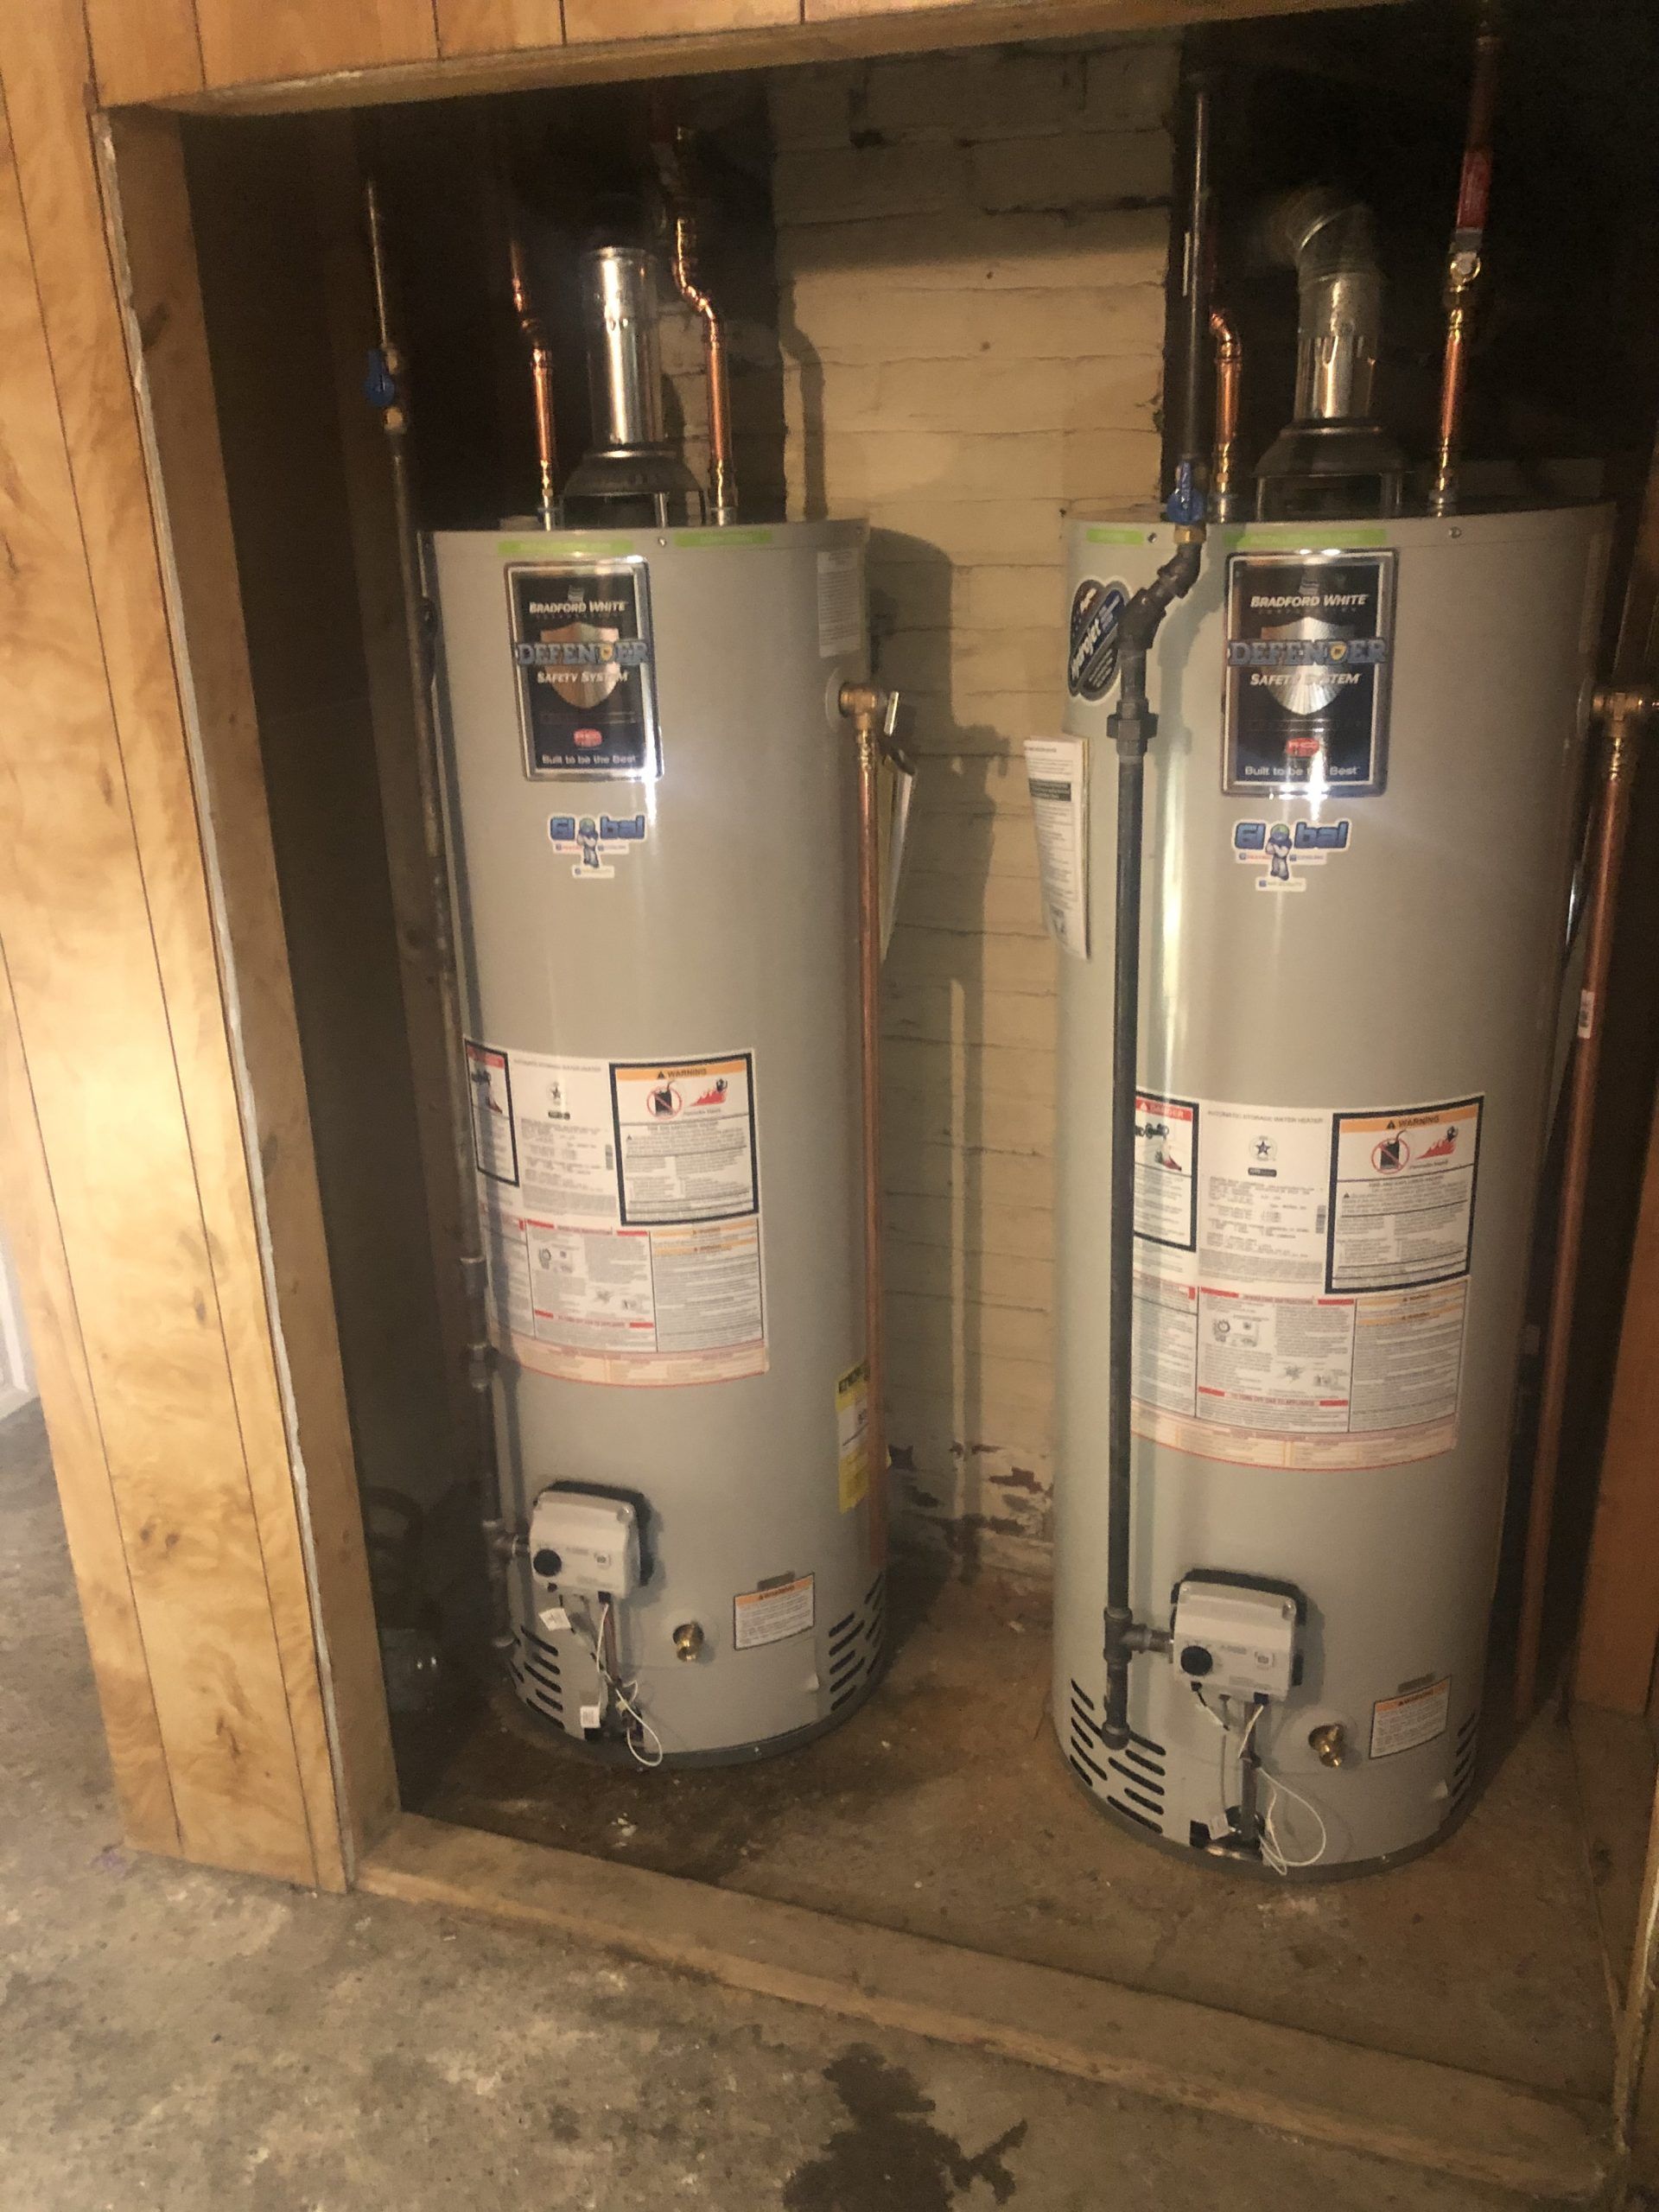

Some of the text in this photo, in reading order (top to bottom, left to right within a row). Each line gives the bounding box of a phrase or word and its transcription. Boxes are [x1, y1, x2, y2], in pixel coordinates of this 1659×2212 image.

[1250, 594, 1367, 607] BRADFORD WHITE
[530, 601, 626, 613] BRADFORD WHITE
[518, 641, 648, 664] DEFENDER
[1230, 639, 1385, 666] DEFENDER
[537, 671, 629, 683] SAFETY SYSM
[1305, 673, 1361, 684] STEM
[1245, 766, 1270, 776] Built
[1273, 766, 1284, 776] to
[1330, 766, 1357, 776] Best
[1235, 821, 1349, 850] Global
[667, 1068, 707, 1077] WARNING
[1398, 1115, 1440, 1127] WARNING
